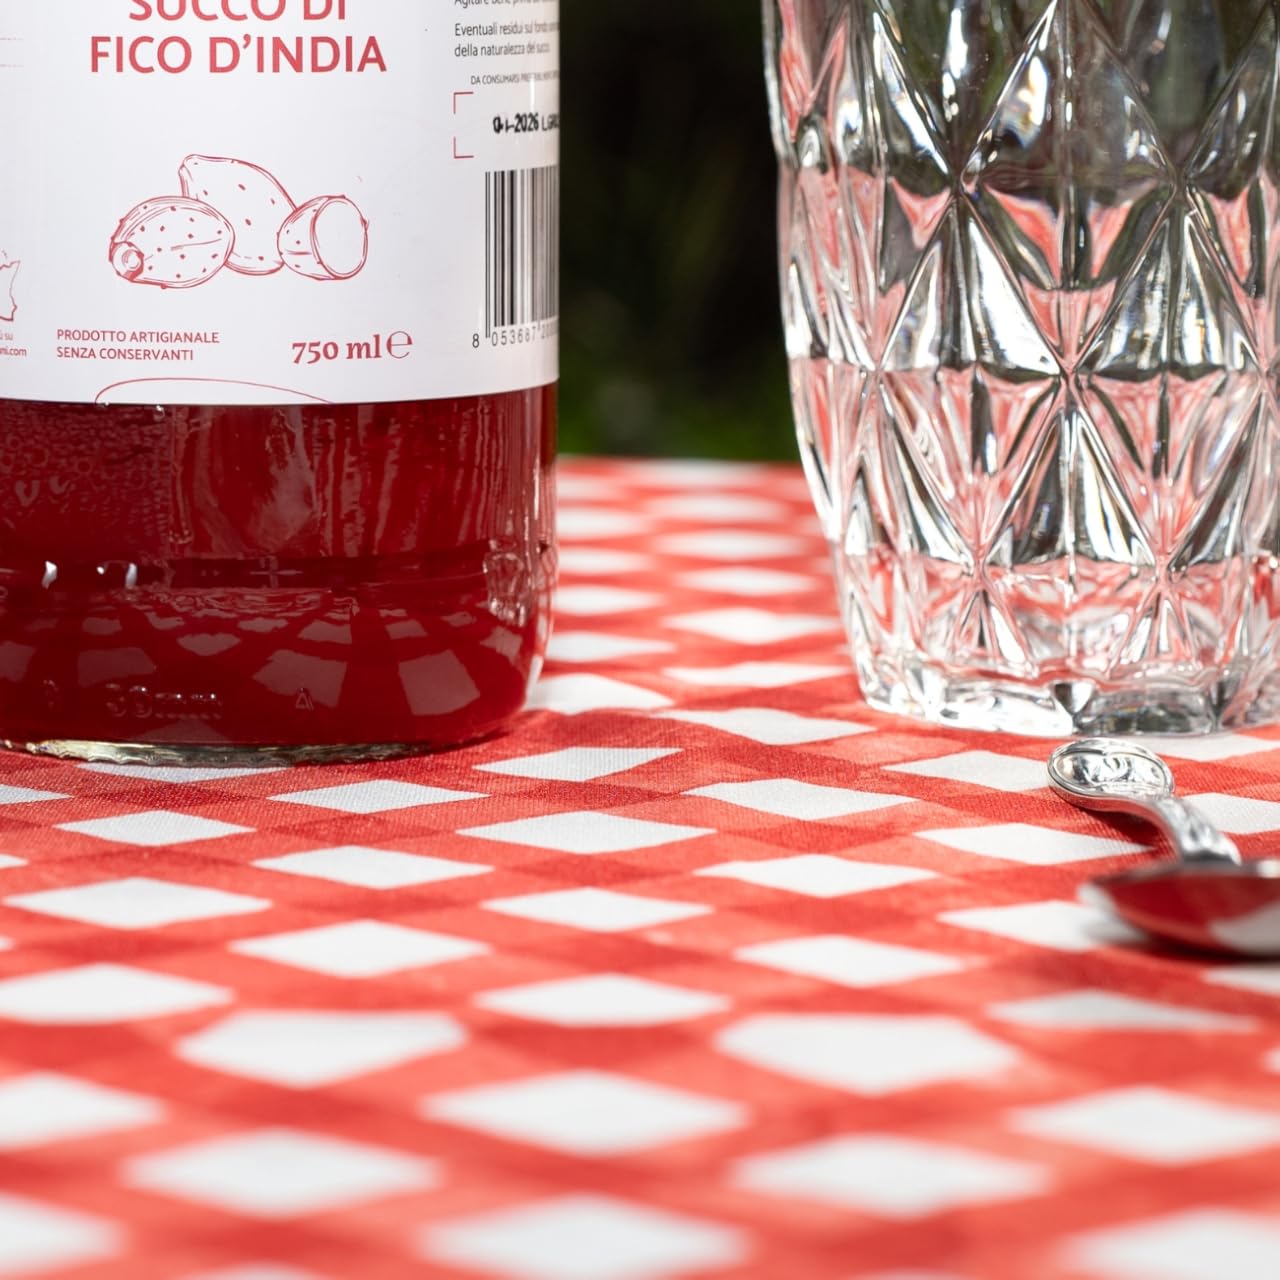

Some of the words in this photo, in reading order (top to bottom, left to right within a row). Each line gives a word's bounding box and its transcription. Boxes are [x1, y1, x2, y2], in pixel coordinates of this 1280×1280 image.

[454, 22, 498, 36] Eventuali
[90, 35, 193, 74] FICO
[209, 33, 387, 74] D'INDIA
[454, 43, 478, 57] della
[470, 75, 481, 85] DA
[56, 329, 126, 342] PRODOTTO
[129, 331, 220, 344] ARTIGIANALE
[472, 333, 480, 348] 8
[56, 346, 96, 359] SENZA
[99, 348, 194, 361] CONSERVANTI
[291, 340, 339, 365] 750
